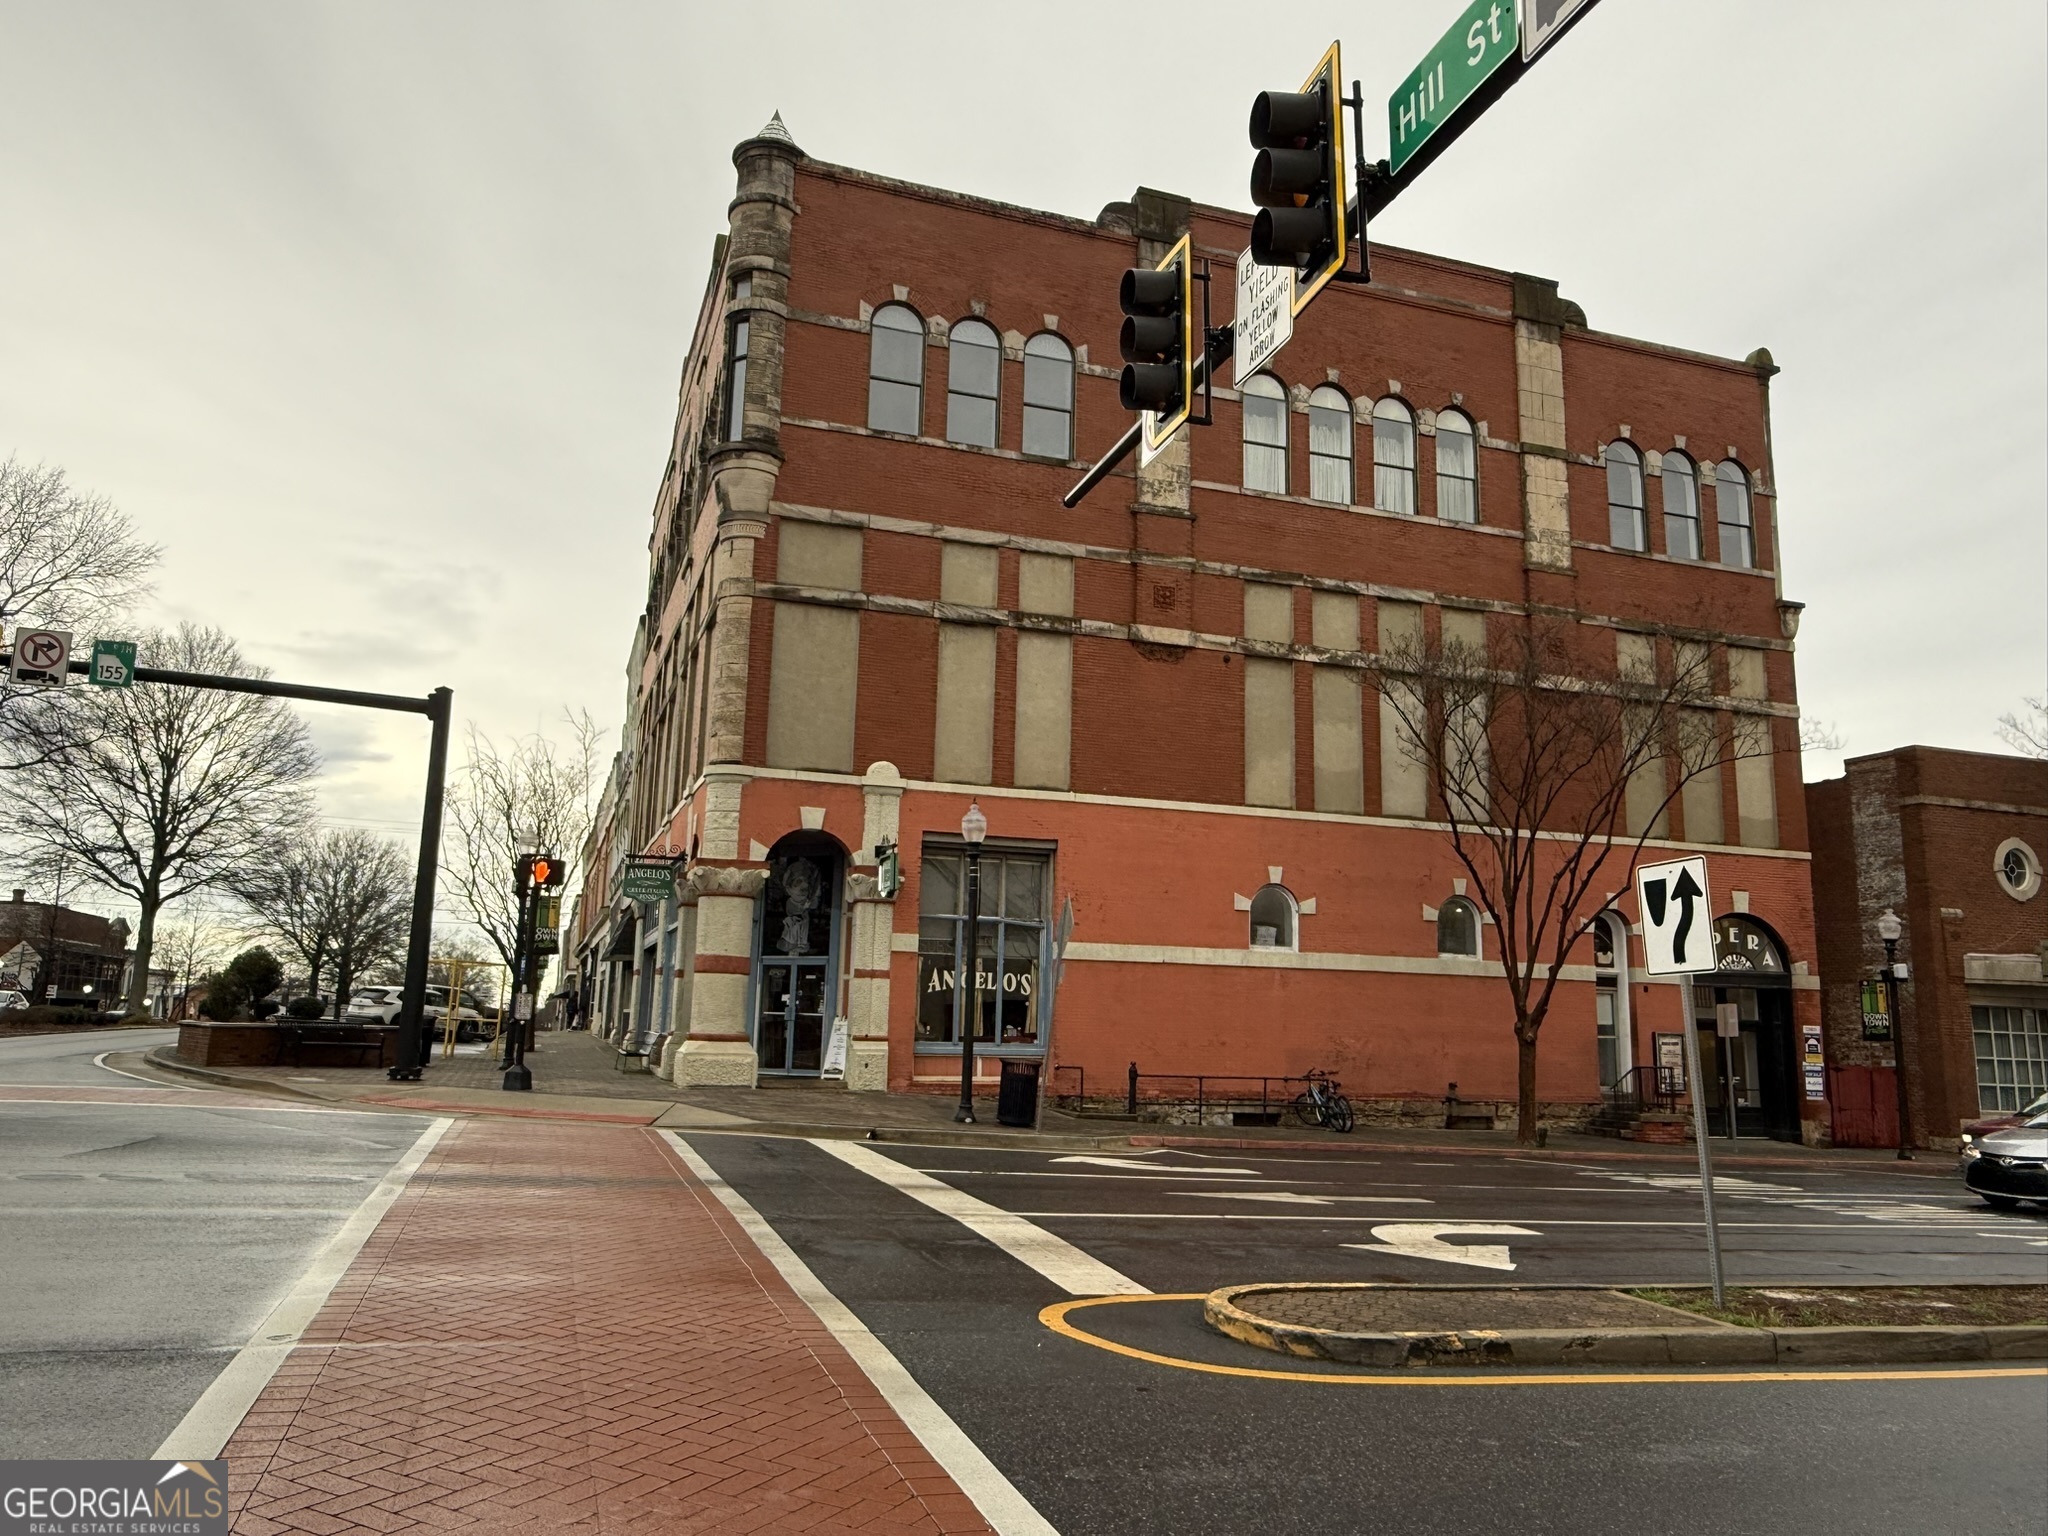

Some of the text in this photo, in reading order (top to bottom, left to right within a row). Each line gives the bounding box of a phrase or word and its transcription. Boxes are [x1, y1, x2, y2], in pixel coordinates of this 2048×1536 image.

[1399, 1, 1502, 144] Hill St
[1240, 259, 1259, 287] LEF
[1248, 266, 1279, 304] YIELD
[1238, 276, 1289, 338] ON FLASHING
[1248, 305, 1279, 346] YELLOW
[1248, 328, 1276, 366] ARROW
[99, 665, 123, 680] 155
[627, 868, 671, 881] ANGELO'S
